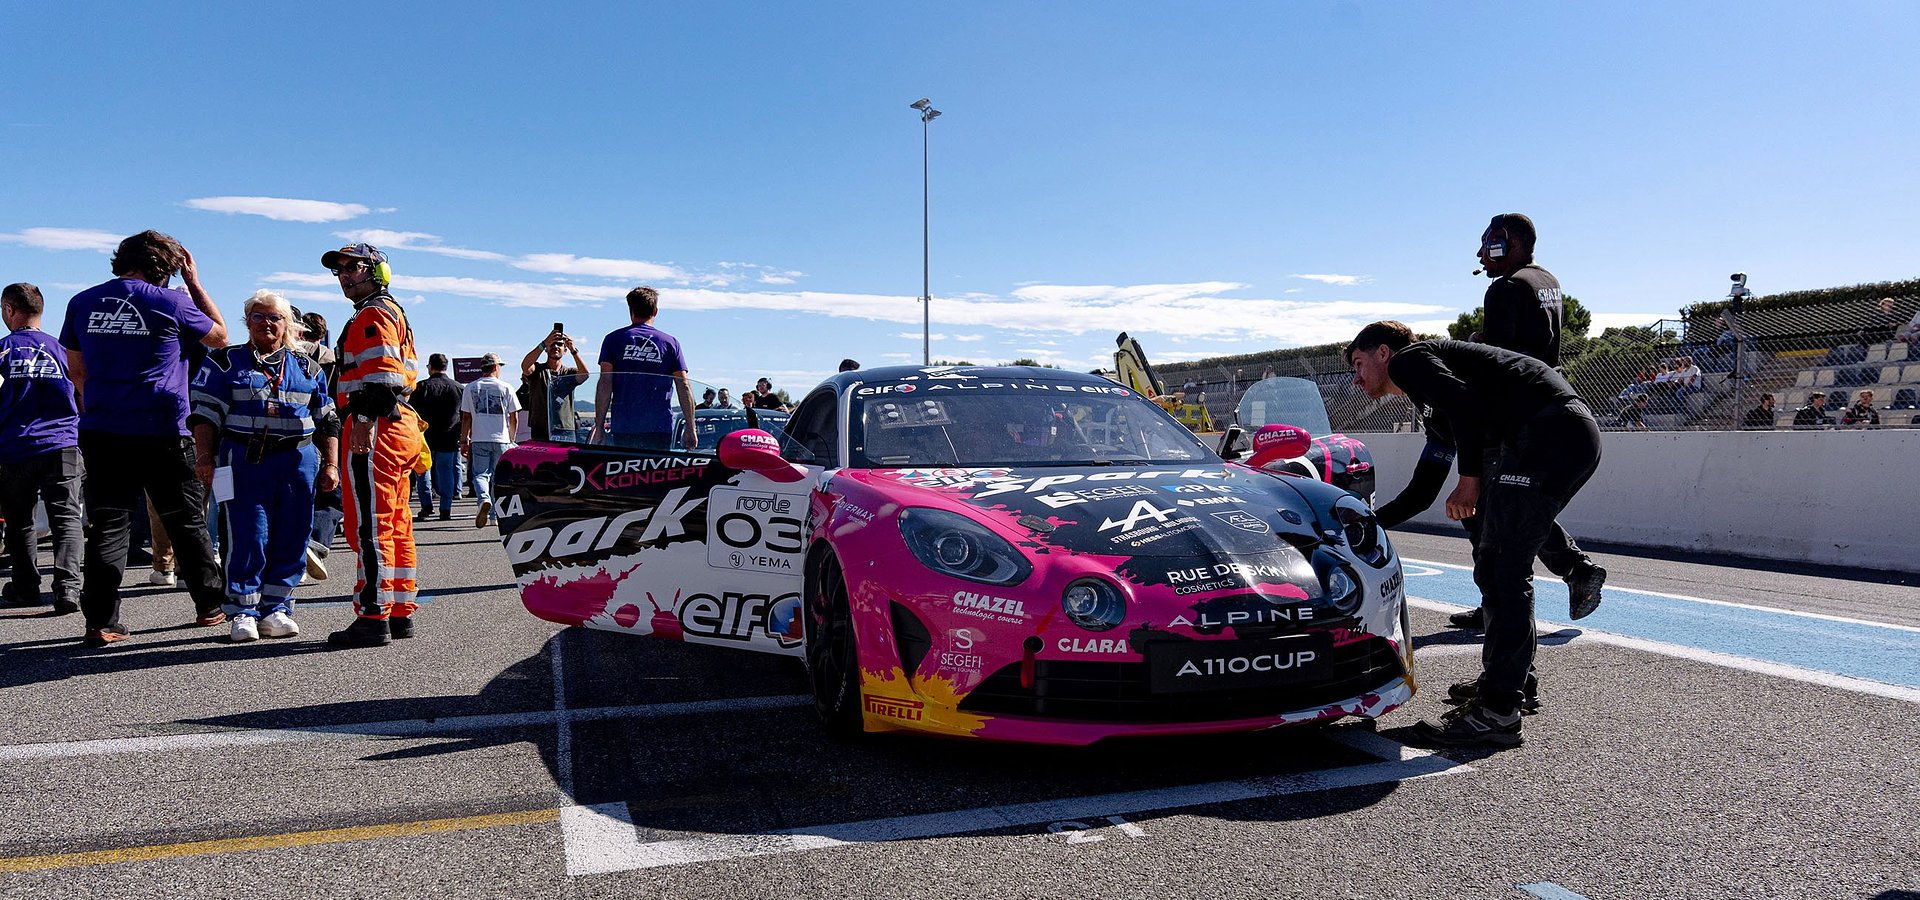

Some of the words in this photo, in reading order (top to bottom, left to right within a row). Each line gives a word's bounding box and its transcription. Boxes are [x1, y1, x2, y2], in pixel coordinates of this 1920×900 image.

[88, 320, 138, 330] LIFE
[89, 312, 132, 320] ONE
[624, 351, 656, 359] LIFE
[10, 366, 54, 374] LIFE
[858, 387, 893, 395] elf
[928, 383, 1076, 392] ALPINE
[1081, 386, 1111, 394] elf
[1258, 429, 1297, 441] CHAZEL
[605, 457, 712, 475] DRIVING
[604, 466, 709, 490] KONCEPT
[1500, 474, 1531, 484] CHAZEL
[716, 512, 802, 554] 03
[1110, 525, 1160, 544] STRASBOURG
[749, 555, 792, 569] YEMA
[1167, 567, 1212, 584] RUE
[1245, 564, 1288, 578] SKIN
[1175, 578, 1236, 596] COSMETICS
[953, 591, 1026, 617] CHAZEL
[682, 594, 768, 638] elf
[953, 606, 995, 621] technologie
[997, 615, 1024, 626] course
[1167, 607, 1315, 629] ALPINE
[1057, 638, 1128, 654] CLARA
[940, 652, 982, 669] SEGEFI
[863, 693, 925, 721] PIRELLI
